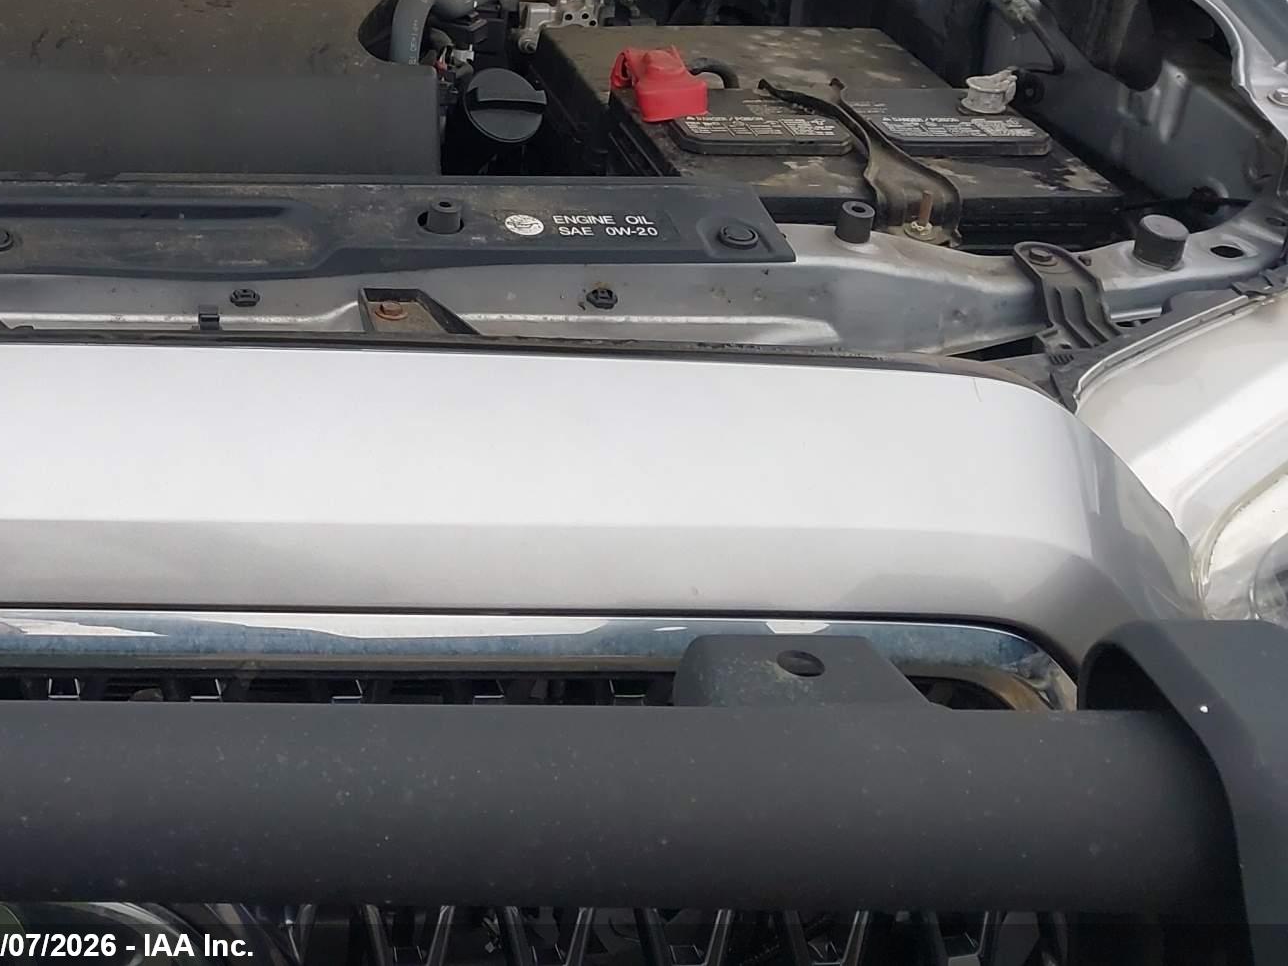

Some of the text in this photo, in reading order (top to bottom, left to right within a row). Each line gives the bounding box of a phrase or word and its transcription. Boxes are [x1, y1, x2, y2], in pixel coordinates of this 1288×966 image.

[553, 215, 616, 225] ENGINE
[626, 215, 654, 225] OIL
[560, 226, 658, 236] SAE 0W-20
